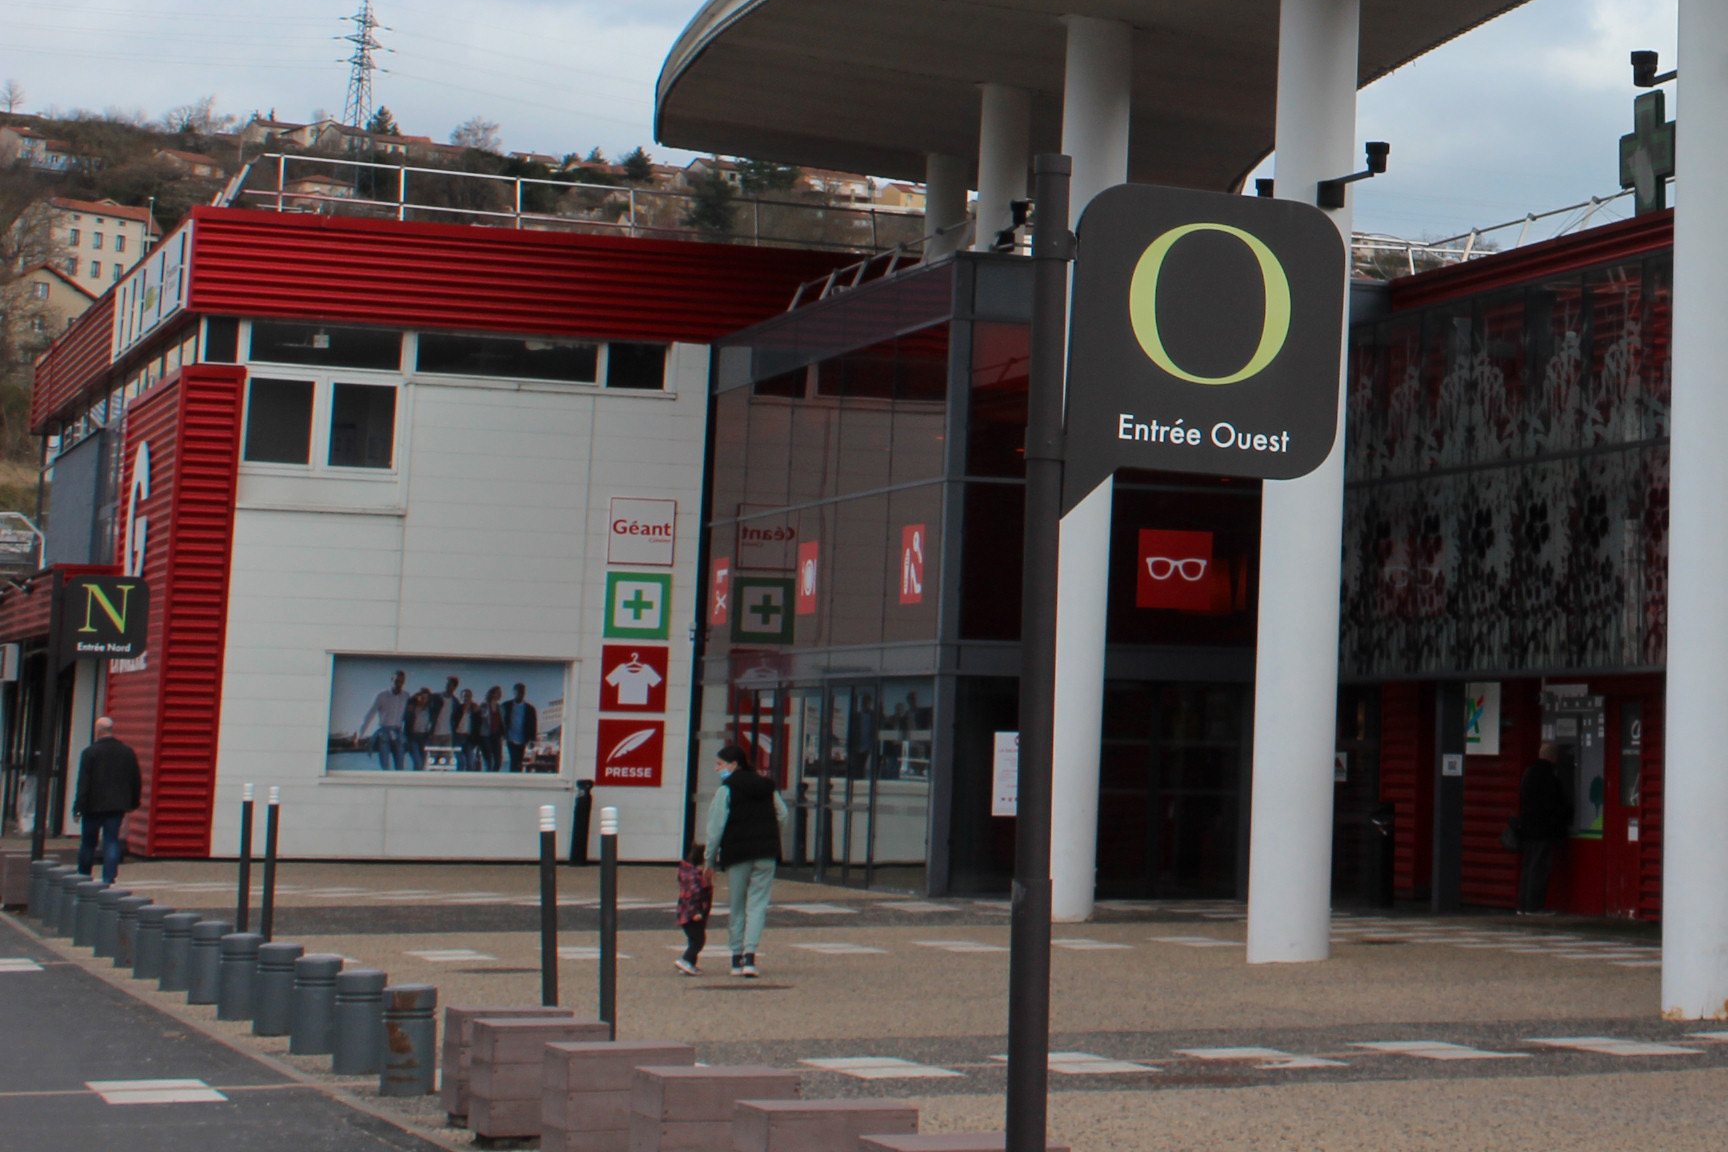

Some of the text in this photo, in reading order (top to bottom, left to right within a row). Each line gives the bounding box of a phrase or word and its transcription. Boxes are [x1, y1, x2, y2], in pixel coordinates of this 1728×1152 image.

[1129, 223, 1291, 385] O
[1118, 414, 1290, 452] Entrée Ouest
[612, 519, 671, 536] Géant
[78, 583, 135, 634] N
[77, 641, 131, 653] Entrée Nord
[604, 766, 652, 778] PRESSE
